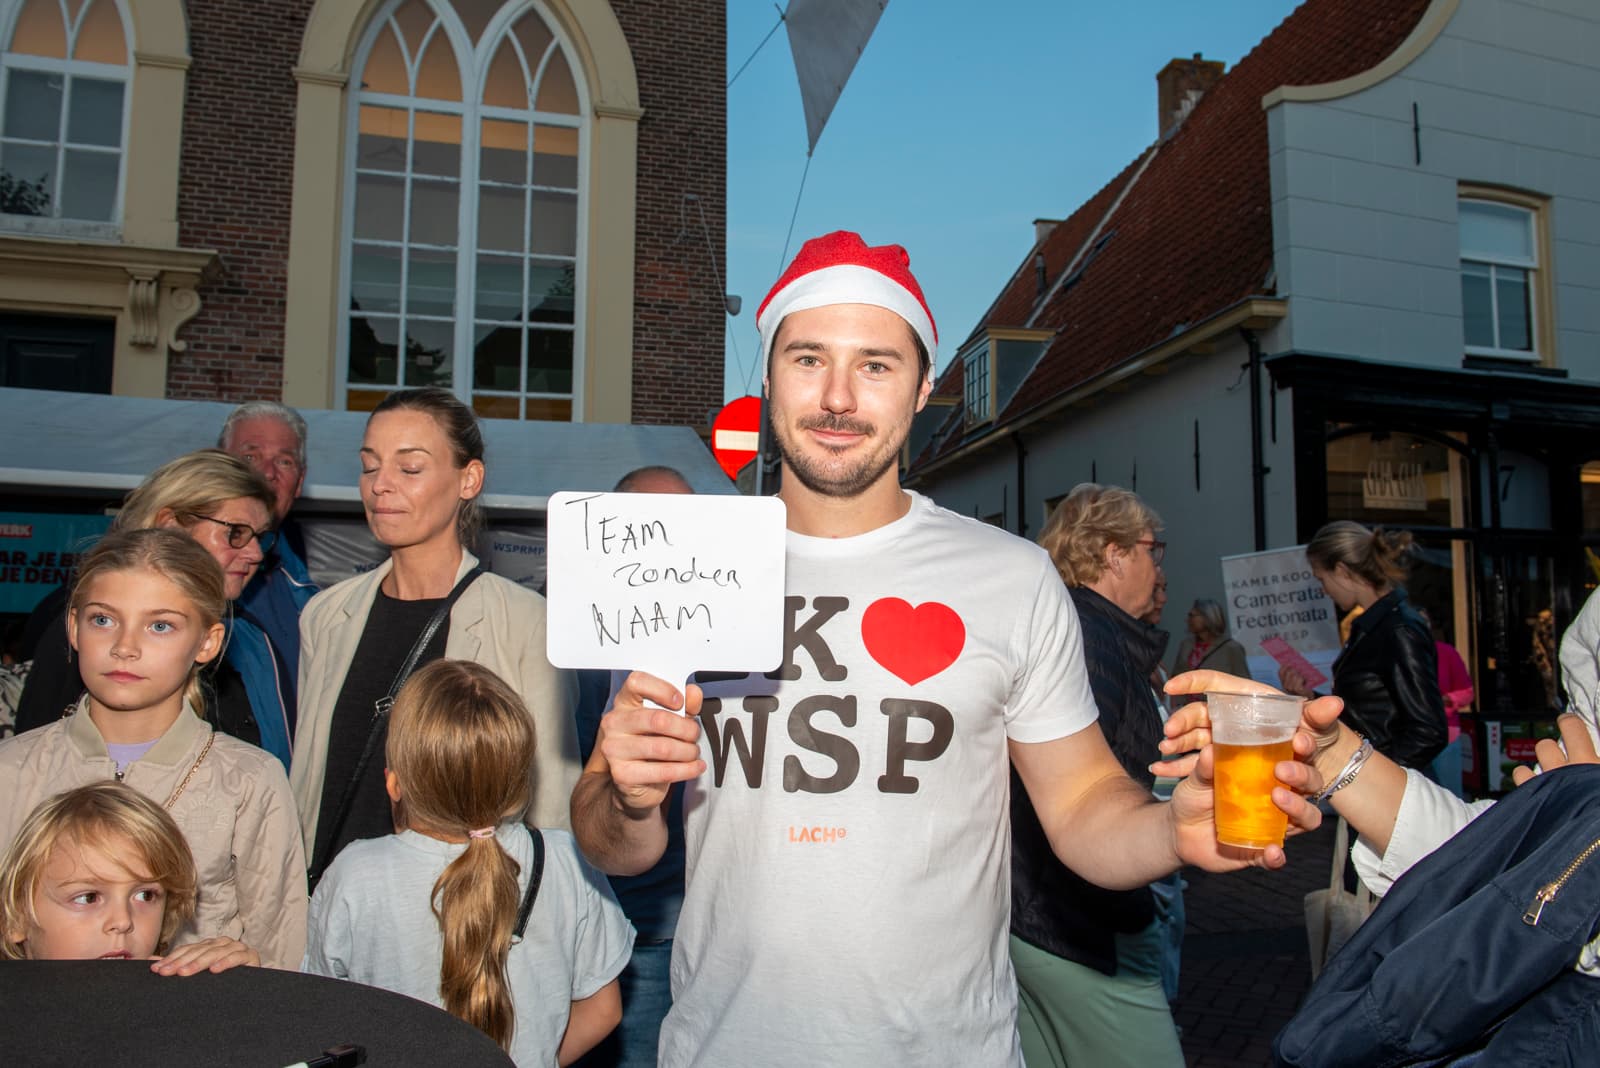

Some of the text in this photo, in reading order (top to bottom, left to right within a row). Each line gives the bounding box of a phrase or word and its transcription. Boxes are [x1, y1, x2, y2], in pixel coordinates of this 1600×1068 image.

[1499, 465, 1515, 502] 7
[0, 524, 30, 536] ERK
[565, 494, 674, 554] TEAM
[31, 551, 56, 567] JE
[1233, 586, 1325, 610] Camerata
[1236, 607, 1328, 629] Fectionata
[697, 694, 955, 794] WSP
